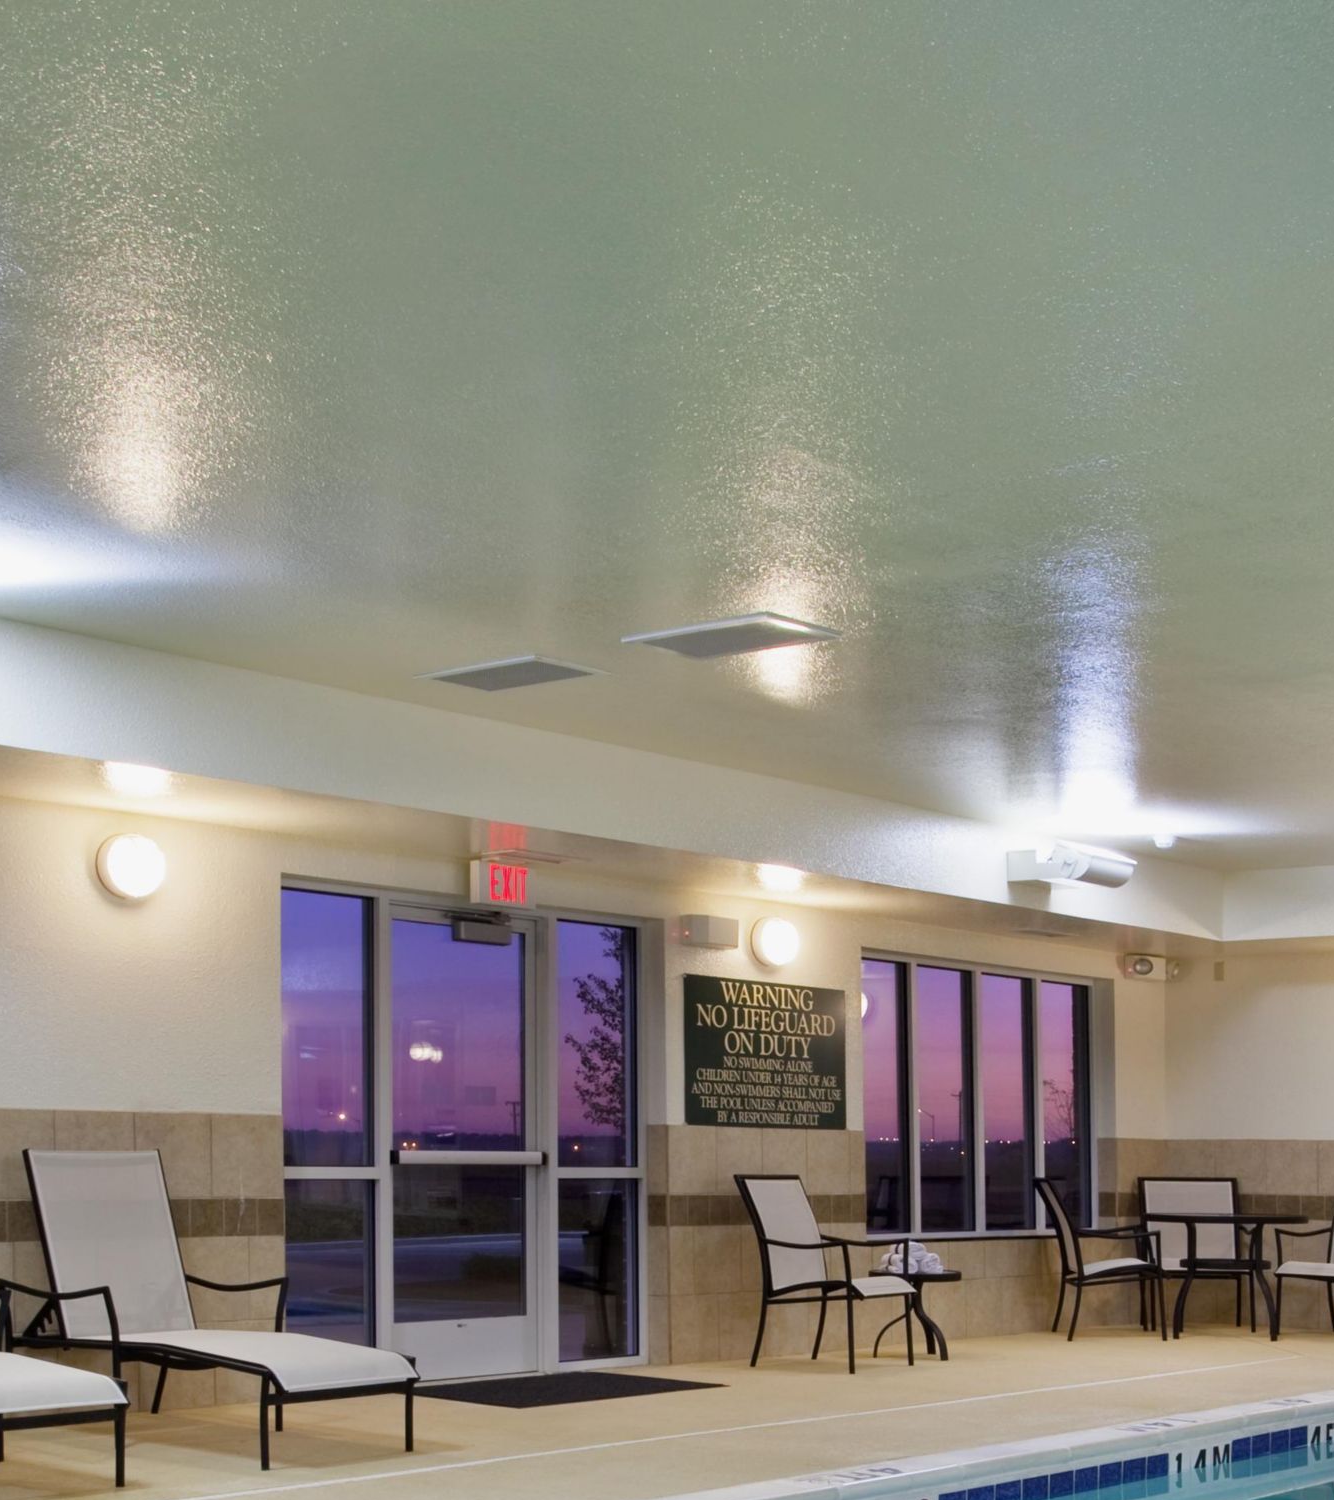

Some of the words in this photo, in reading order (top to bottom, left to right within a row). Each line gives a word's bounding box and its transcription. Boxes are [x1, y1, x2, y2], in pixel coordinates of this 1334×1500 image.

[490, 863, 528, 905] EXIT
[720, 981, 814, 1011] WARNING
[696, 1004, 727, 1028] NO
[732, 1008, 835, 1036] LIFEGUARD
[724, 1031, 753, 1055] ON
[760, 1034, 811, 1058] DUTY
[723, 1055, 737, 1069] NO
[739, 1057, 784, 1071] SWIMMING
[786, 1060, 814, 1073] ALONE
[696, 1067, 741, 1082] CHILDREN
[742, 1071, 772, 1084] UNDER
[774, 1073, 782, 1085] 14
[783, 1073, 808, 1086] YEARS
[809, 1075, 820, 1086] OF
[821, 1075, 837, 1087] AGE
[691, 1081, 713, 1094] AND
[713, 1082, 780, 1097] NON-SWIMMERS
[782, 1087, 807, 1099] SHALL
[808, 1088, 825, 1100] NOT
[827, 1089, 842, 1101] USE
[699, 1096, 719, 1108] THE
[720, 1096, 743, 1109] POOL
[744, 1098, 776, 1111] UNLESS
[777, 1100, 835, 1113] ACCOMPANIED
[717, 1110, 728, 1123] BY
[730, 1111, 737, 1123] A
[738, 1111, 791, 1125] RESPONSIBLE
[792, 1113, 819, 1126] ADULT
